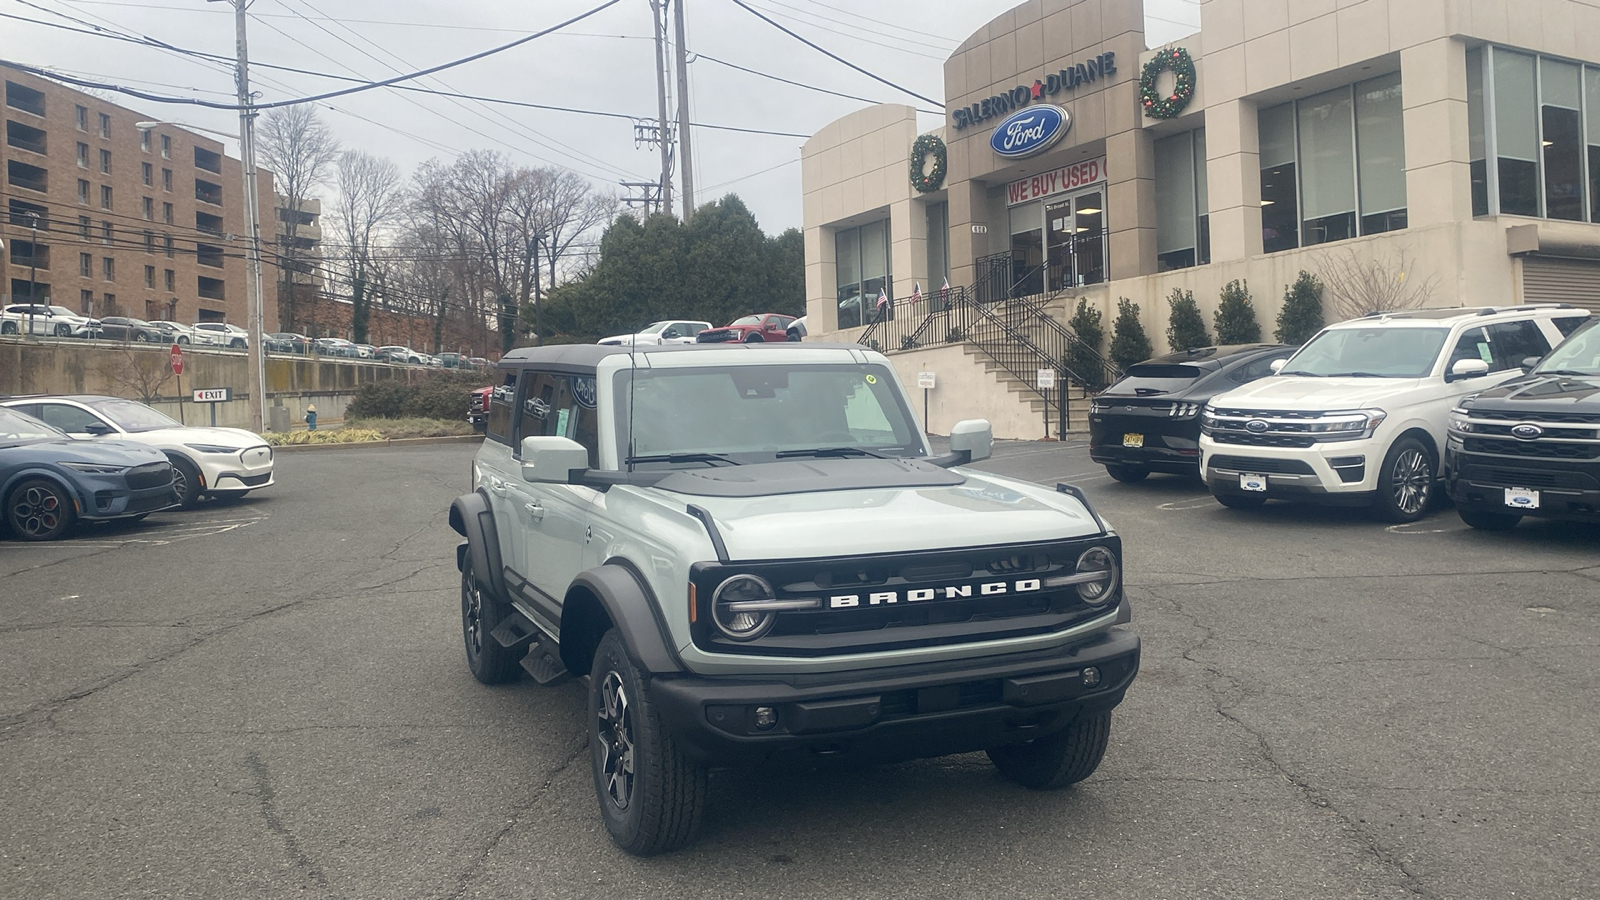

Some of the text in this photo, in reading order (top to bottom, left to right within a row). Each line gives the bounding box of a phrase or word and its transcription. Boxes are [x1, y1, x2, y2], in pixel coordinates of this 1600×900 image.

[952, 52, 1117, 130] SALERNO DUANE
[1004, 116, 1045, 150] Ford
[1008, 180, 1028, 203] WE
[1032, 171, 1058, 197] BUY
[1061, 160, 1098, 189] USED
[171, 353, 182, 366] STOP
[205, 391, 223, 399] EXIT
[830, 578, 1040, 608] BRONCO
